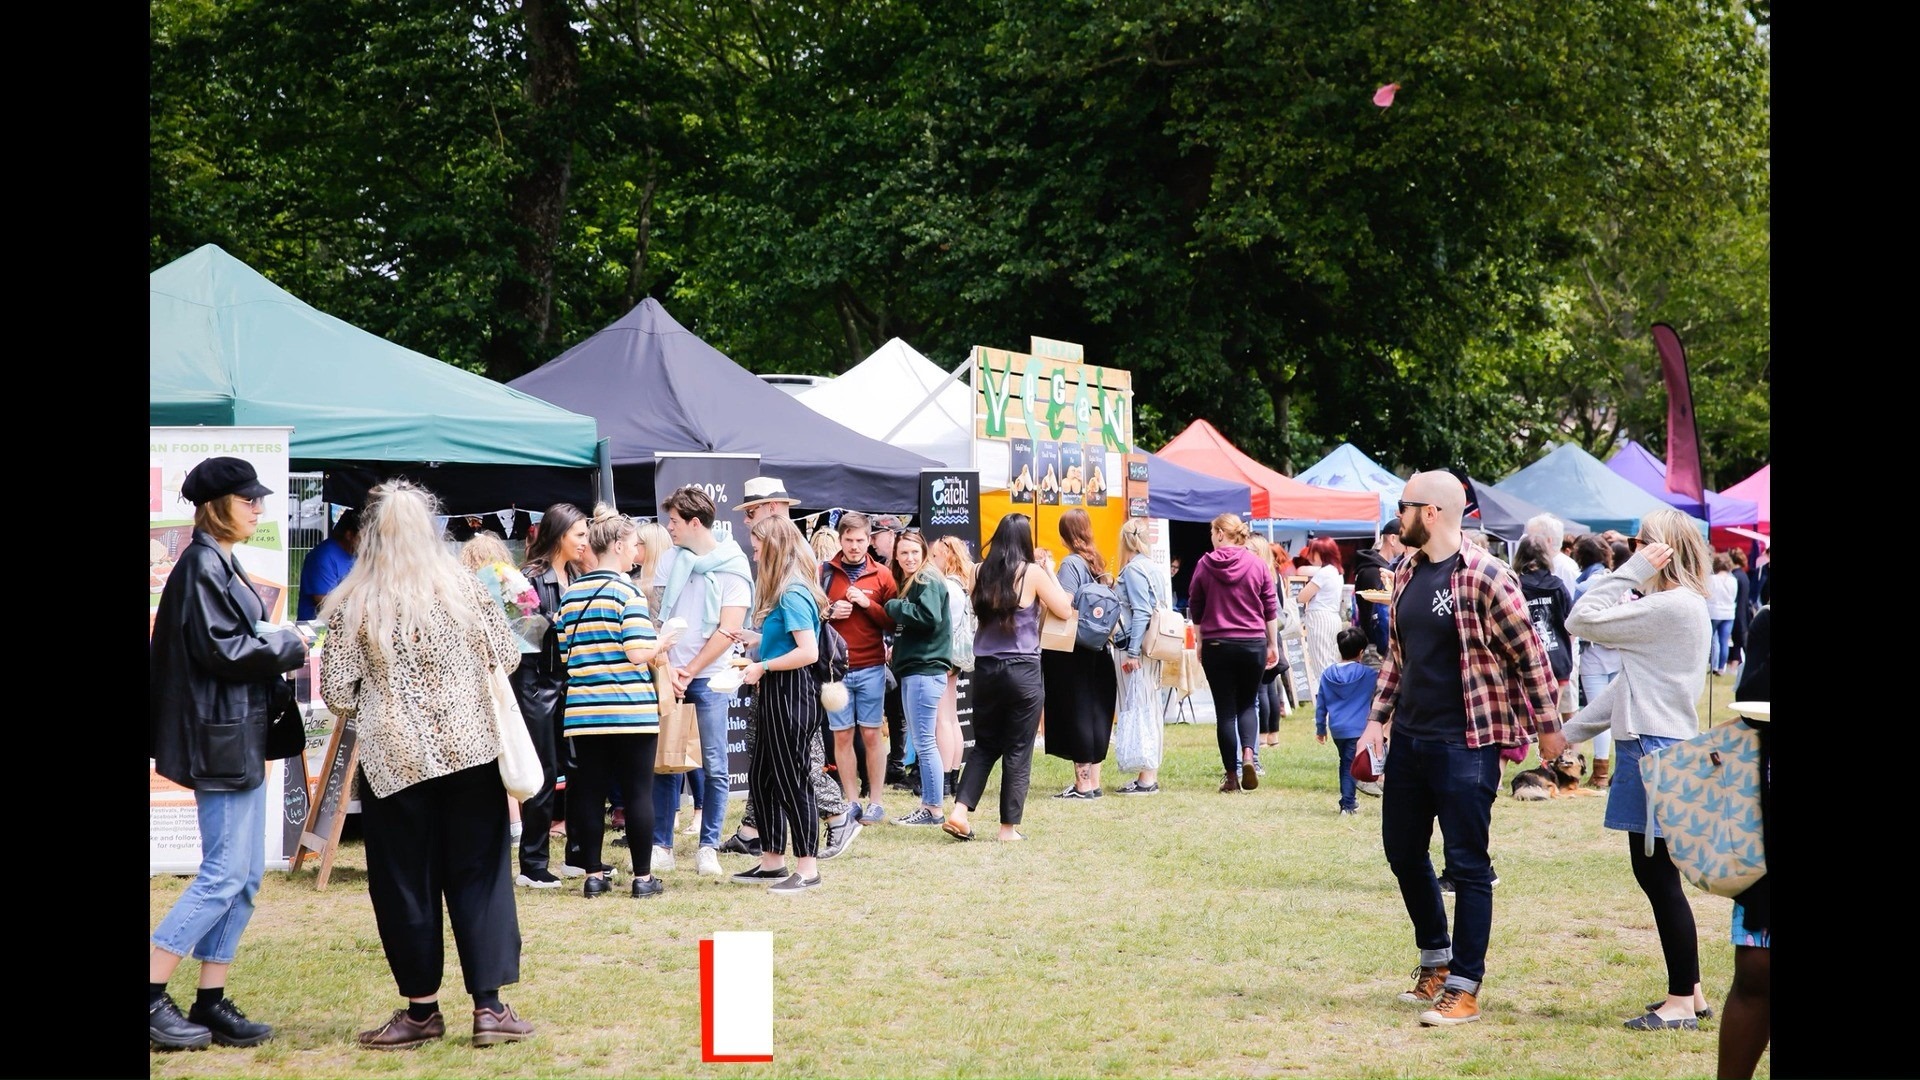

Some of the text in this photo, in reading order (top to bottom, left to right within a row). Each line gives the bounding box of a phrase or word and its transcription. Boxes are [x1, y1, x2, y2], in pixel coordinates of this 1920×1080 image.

[172, 444, 209, 453] FOOD
[213, 444, 282, 453] PLATTERS
[685, 483, 727, 503] 0%
[931, 479, 969, 505] Catch!
[304, 717, 329, 730] HOME
